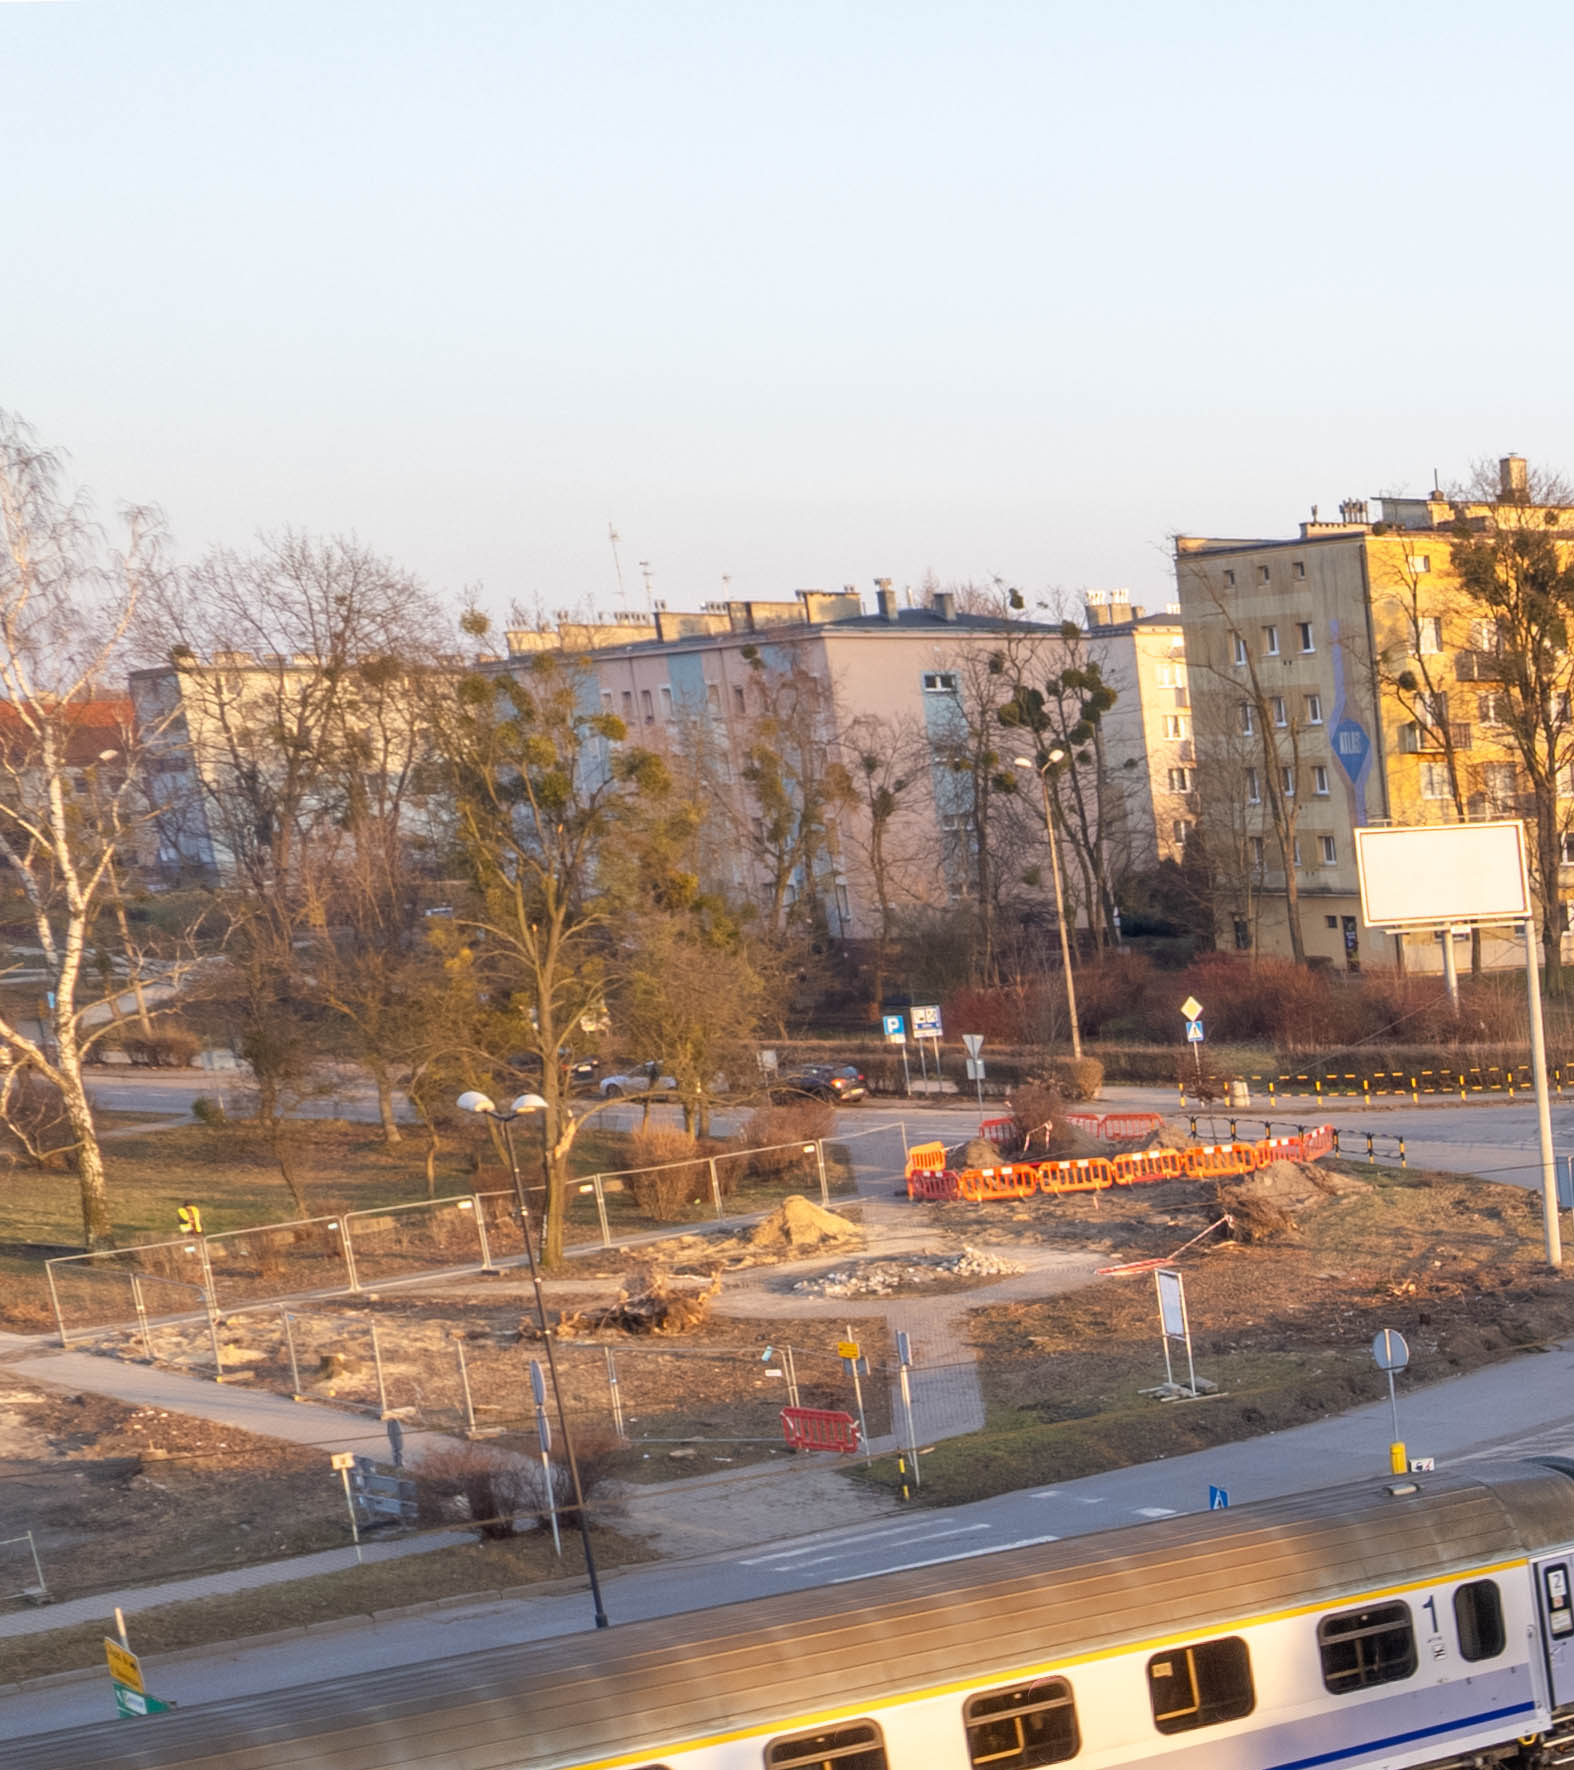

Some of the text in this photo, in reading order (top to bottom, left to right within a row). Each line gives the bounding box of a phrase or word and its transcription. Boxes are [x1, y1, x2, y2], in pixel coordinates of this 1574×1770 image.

[887, 1017, 900, 1032] P
[1553, 1573, 1562, 1589] 2
[1422, 1594, 1439, 1633] 1
